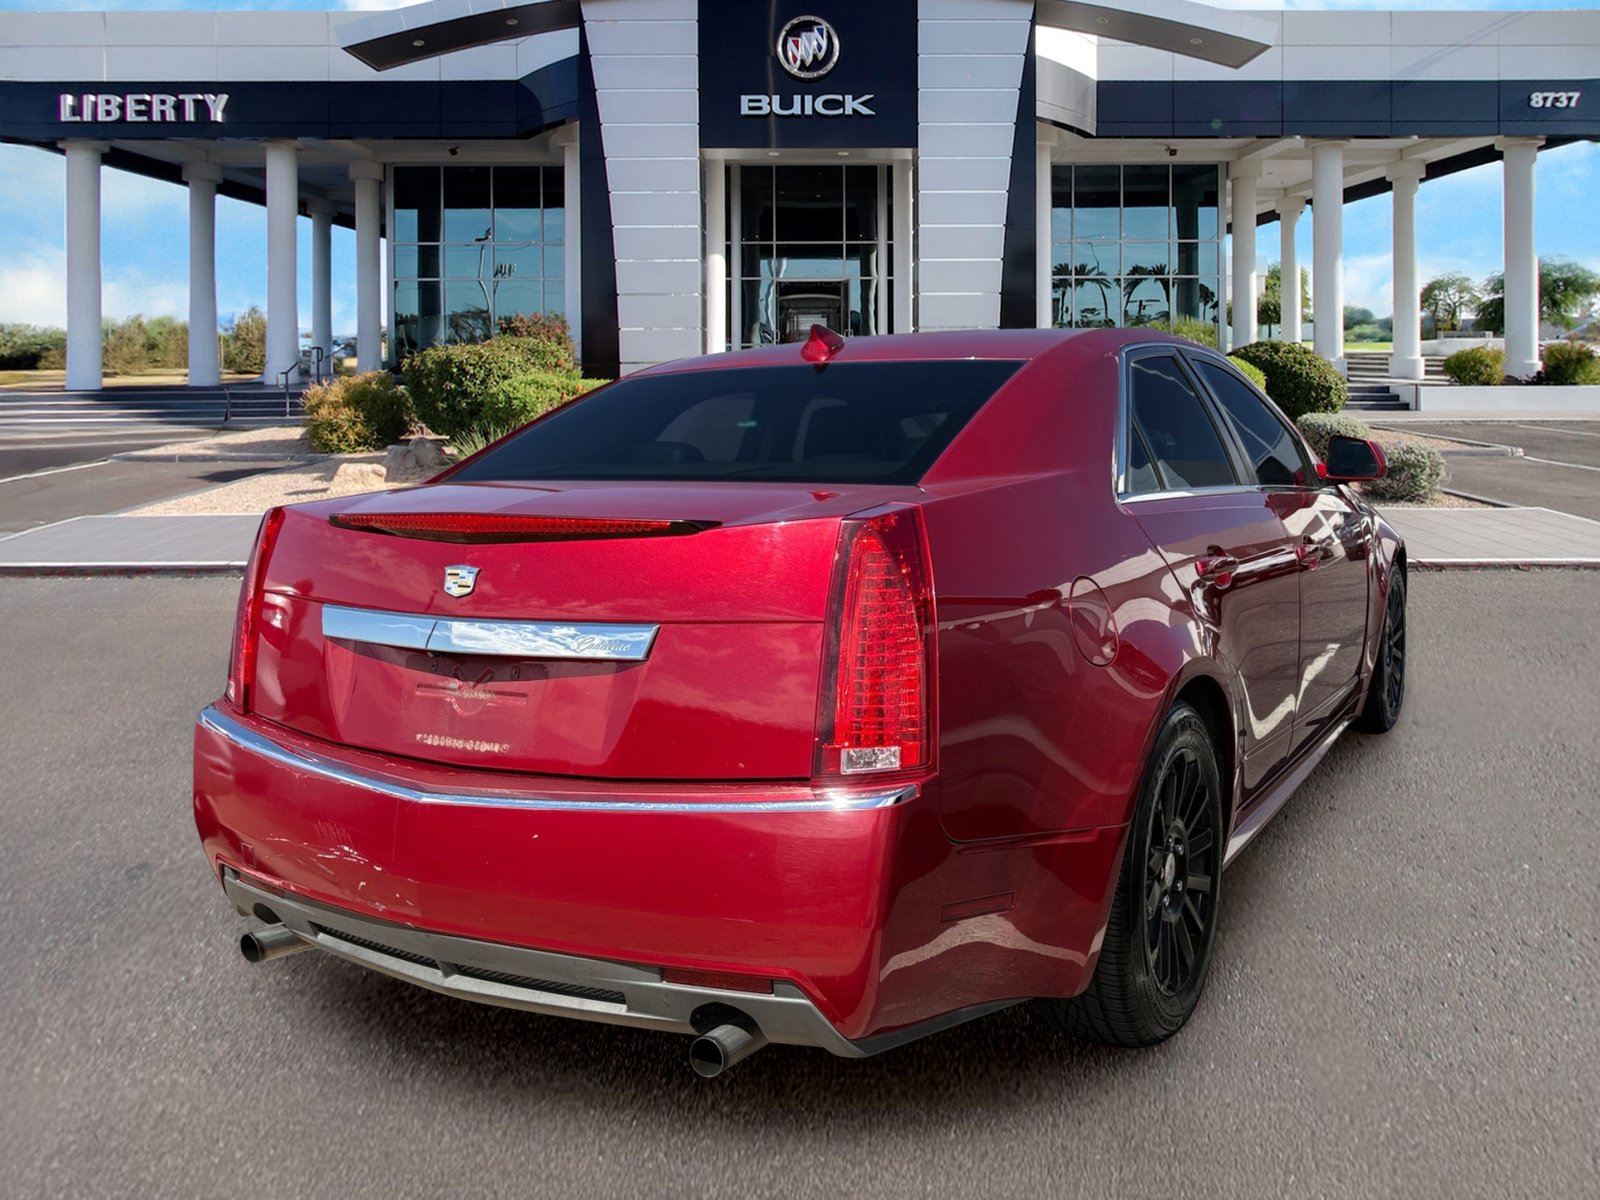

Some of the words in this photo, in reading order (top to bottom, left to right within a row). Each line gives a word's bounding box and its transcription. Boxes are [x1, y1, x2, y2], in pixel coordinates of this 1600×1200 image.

[59, 93, 229, 122] LIBERTY
[740, 94, 876, 115] BUICK
[1529, 91, 1580, 108] 8737
[575, 634, 632, 653] Cadillac
